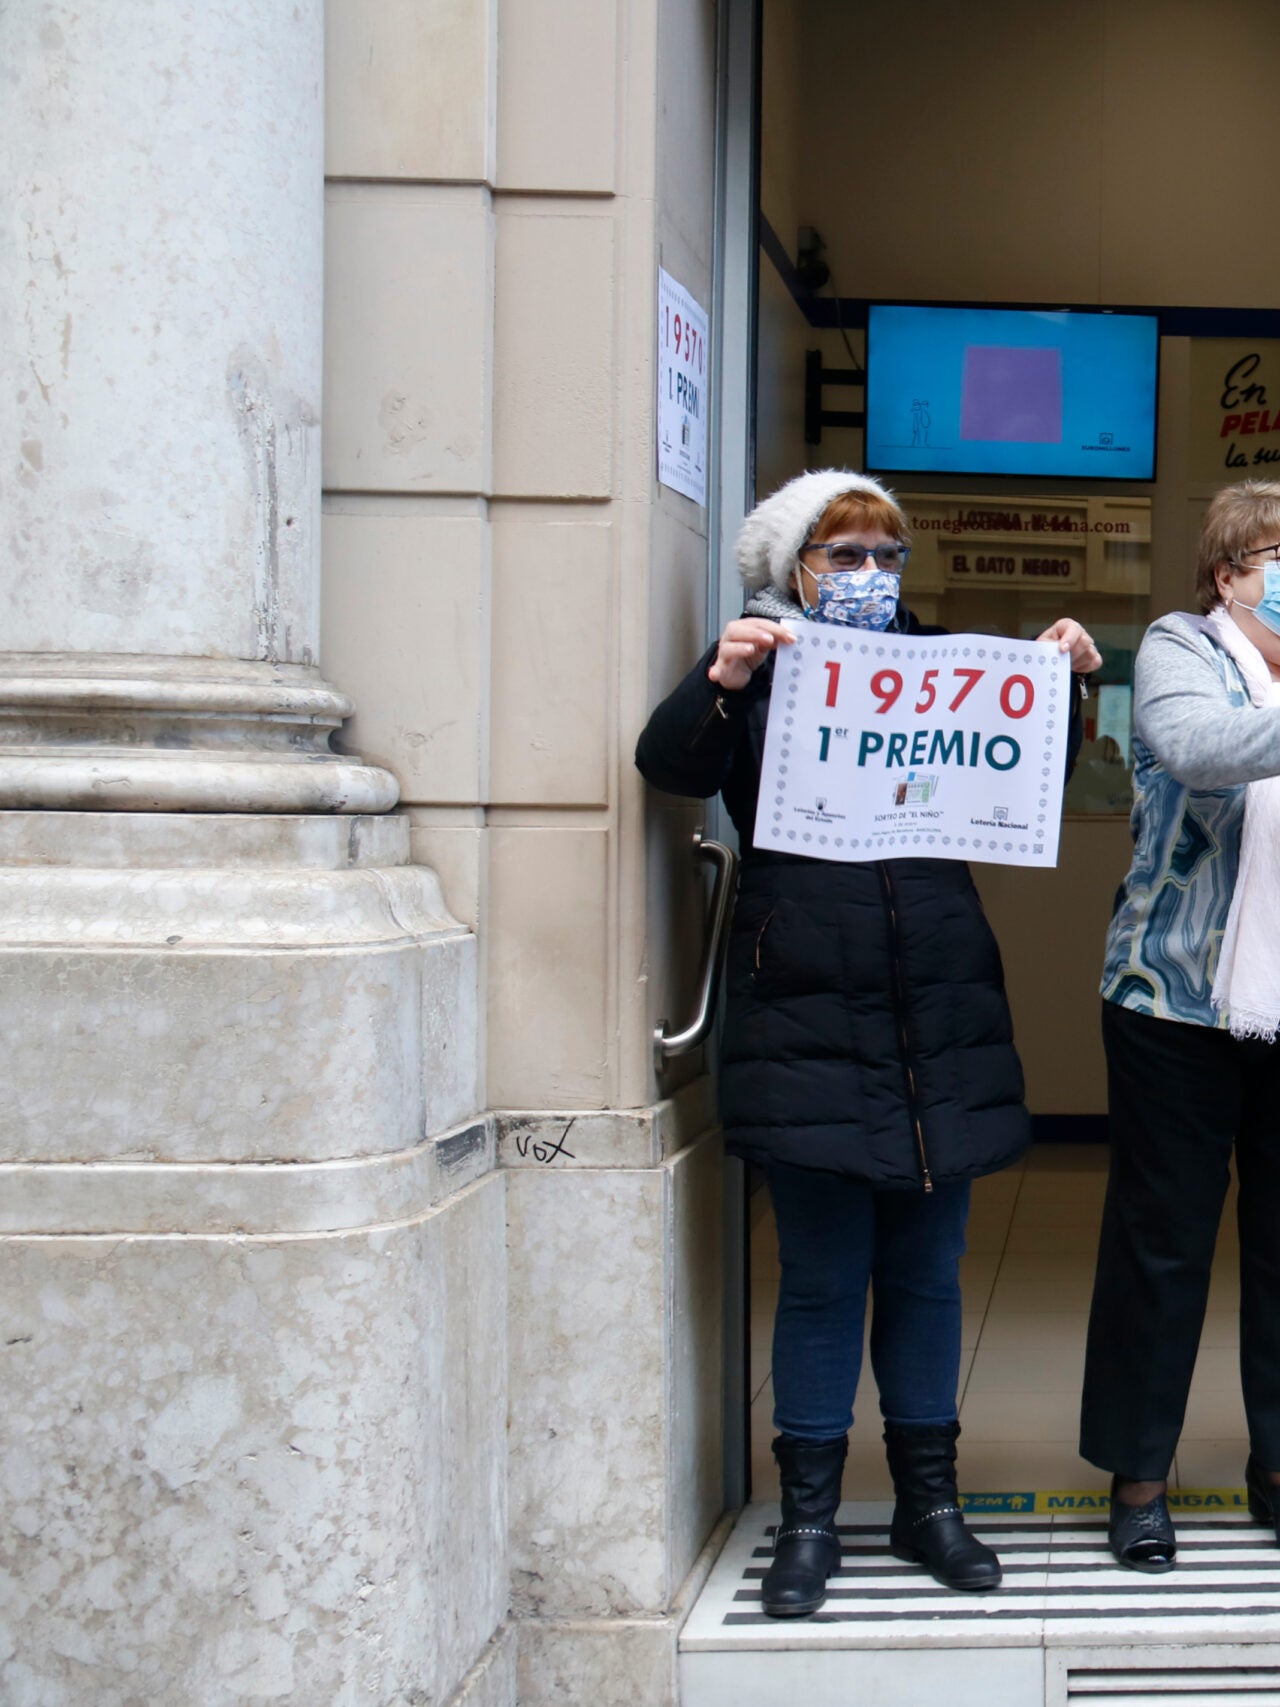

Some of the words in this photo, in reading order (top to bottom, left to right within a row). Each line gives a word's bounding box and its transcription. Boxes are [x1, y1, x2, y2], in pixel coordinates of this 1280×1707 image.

[665, 305, 703, 376] 19570
[1220, 353, 1267, 410] En
[1225, 442, 1248, 469] la
[953, 555, 970, 573] EL
[975, 556, 1015, 574] GATO
[1022, 558, 1070, 577] NEGRO
[824, 660, 1035, 719] 19570
[857, 729, 1021, 771] PREMIO
[998, 821, 1028, 830] Nacional
[1048, 1491, 1223, 1508] MANNGA
